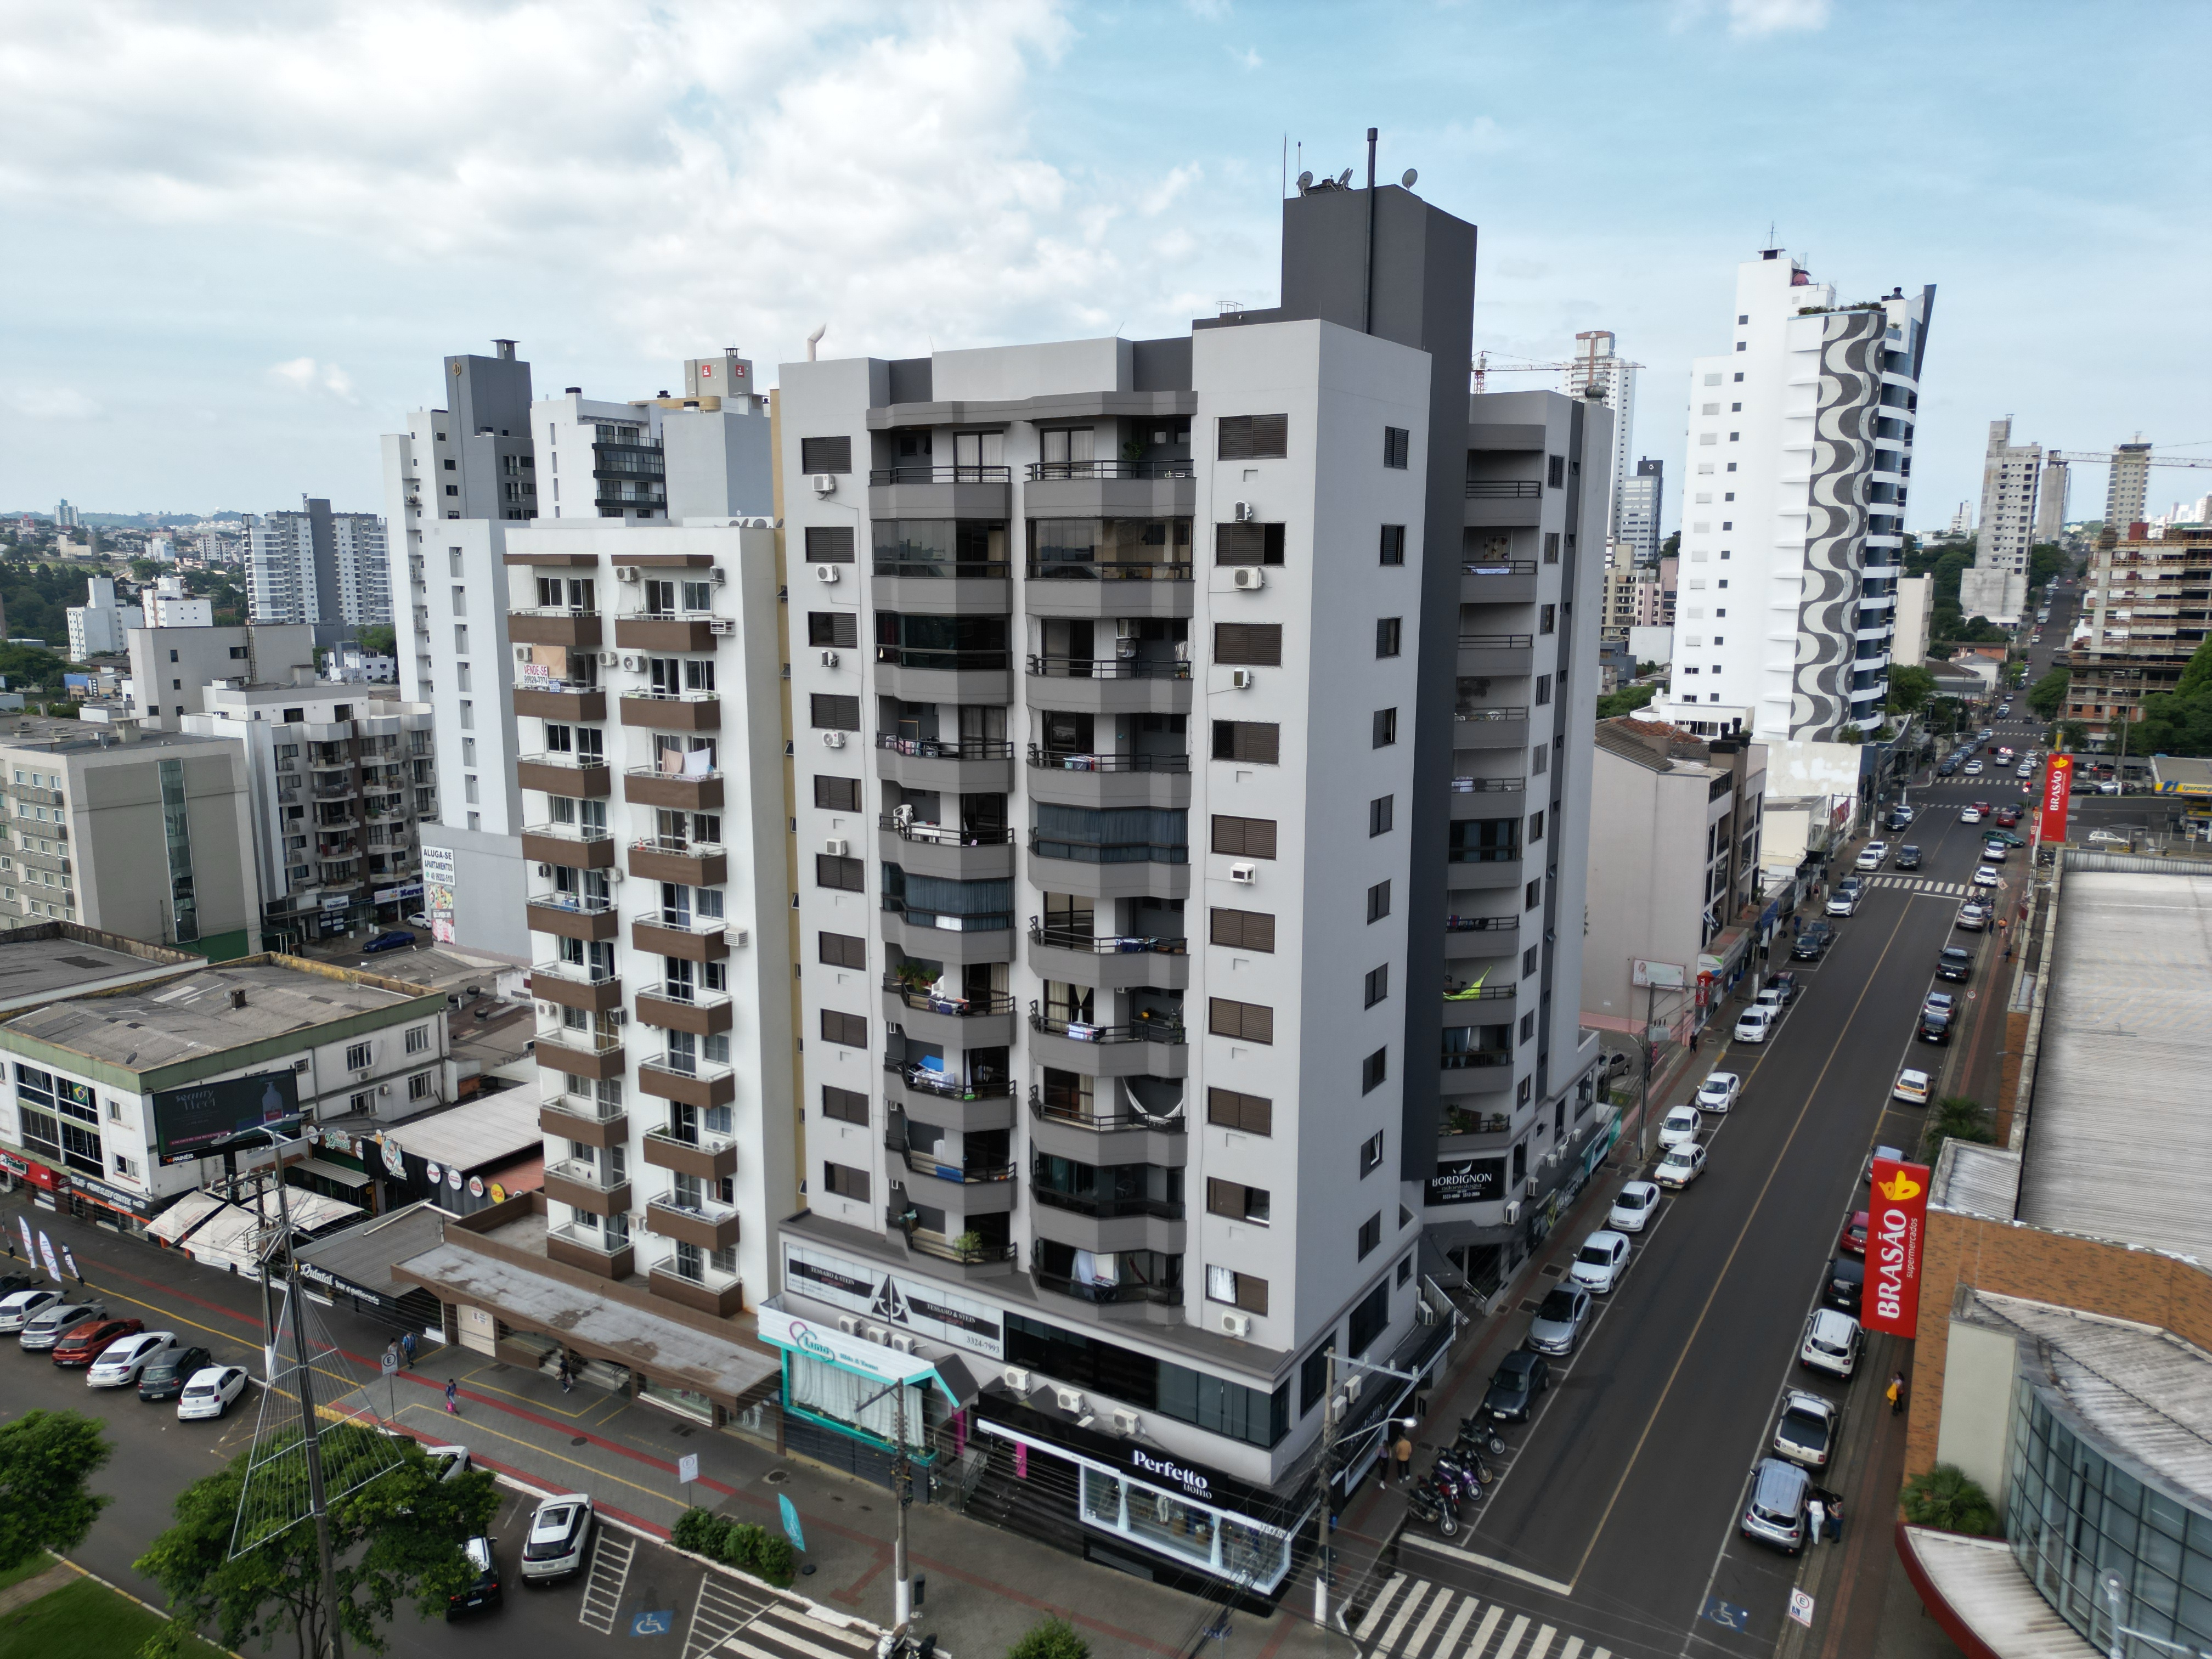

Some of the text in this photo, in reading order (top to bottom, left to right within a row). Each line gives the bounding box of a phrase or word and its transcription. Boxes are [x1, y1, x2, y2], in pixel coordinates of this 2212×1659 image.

[2050, 771, 2062, 811] BRASÃO
[424, 849, 452, 860] ALUGA-SE
[425, 860, 453, 872] APARTAMENTOS
[1432, 1173, 1492, 1187] BORDIGNON
[1906, 1217, 1918, 1278] supermercados
[811, 1267, 834, 1278] TESSARO
[1877, 1209, 1906, 1319] BRASÃO
[300, 1263, 333, 1285] Quintal
[927, 1304, 952, 1316] TESSARO
[959, 1313, 975, 1323] STEIN
[967, 1336, 1000, 1353] 3324-7993
[1133, 1449, 1208, 1489] Perfetto
[1184, 1483, 1212, 1499] uomo
[1800, 1597, 1806, 1606] E
